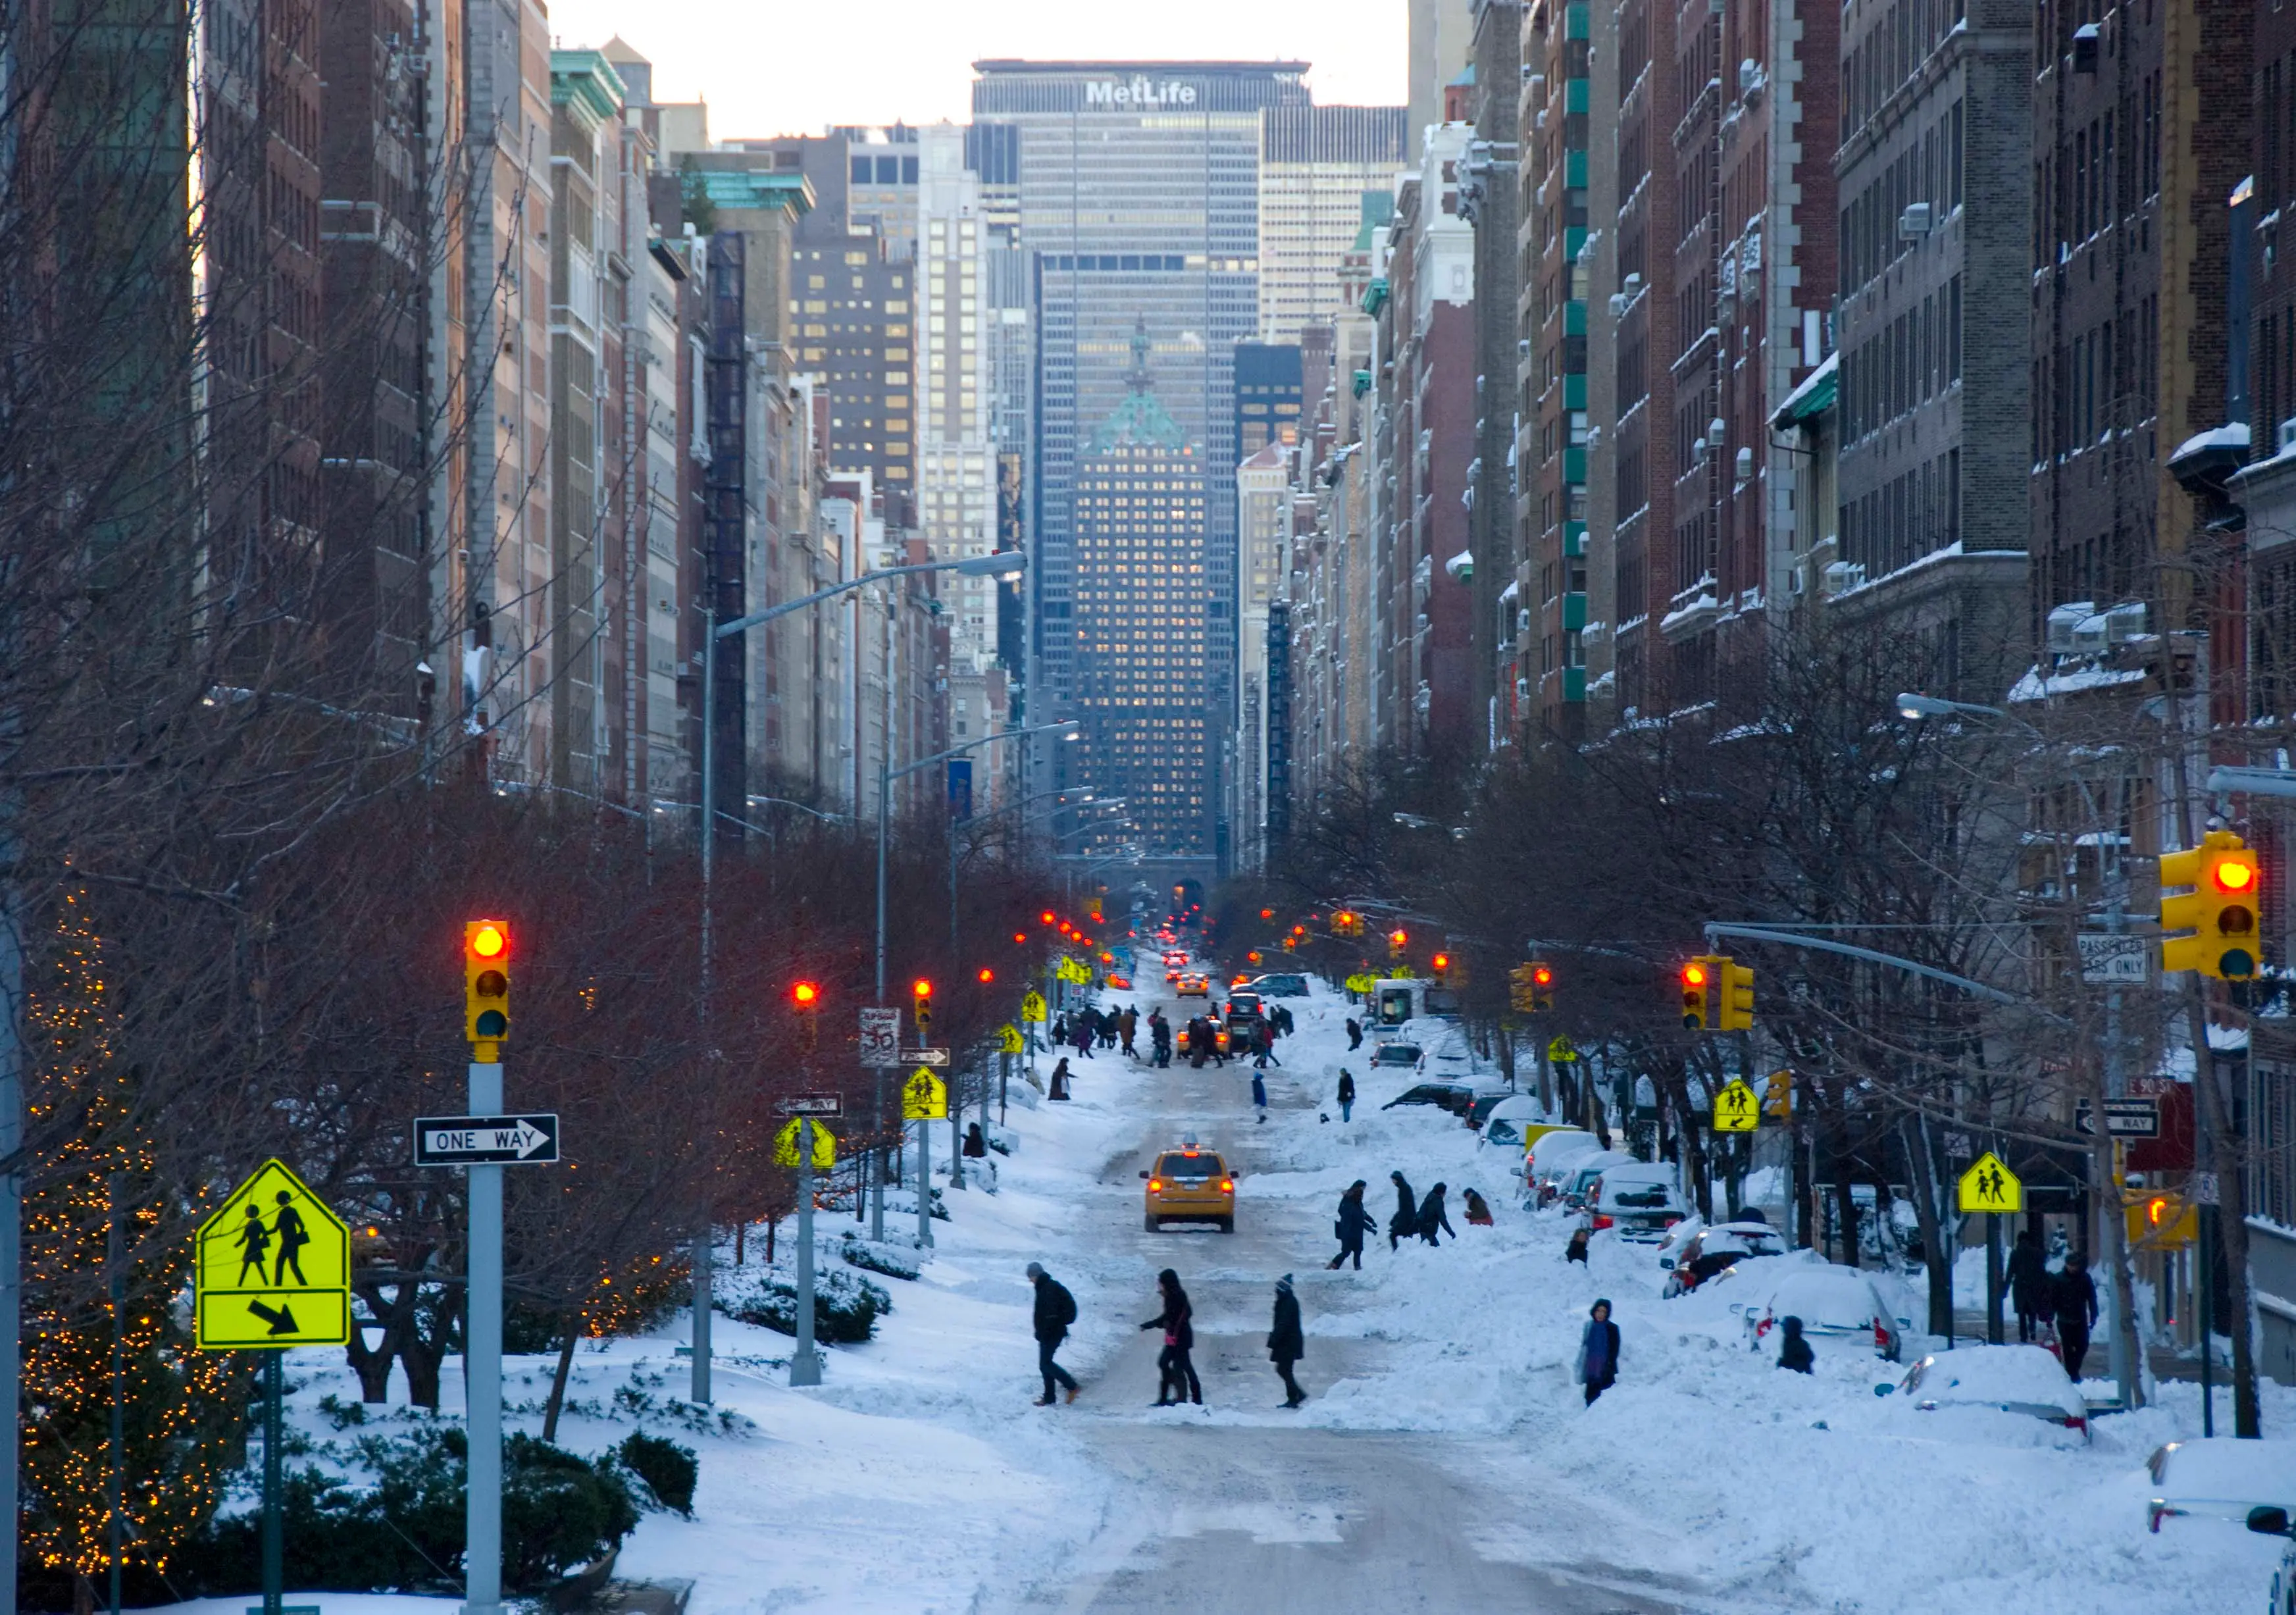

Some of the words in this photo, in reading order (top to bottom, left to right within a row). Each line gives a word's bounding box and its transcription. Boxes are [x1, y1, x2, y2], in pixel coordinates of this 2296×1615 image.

[1086, 80, 1196, 104] MetLife
[2116, 960, 2143, 974] ONLY
[861, 1031, 894, 1050] 30
[2130, 1079, 2136, 1093] E
[2141, 1079, 2155, 1094] 90
[2122, 1118, 2147, 1129] WAY
[437, 1132, 476, 1150] ONE
[495, 1130, 535, 1148] WAY
